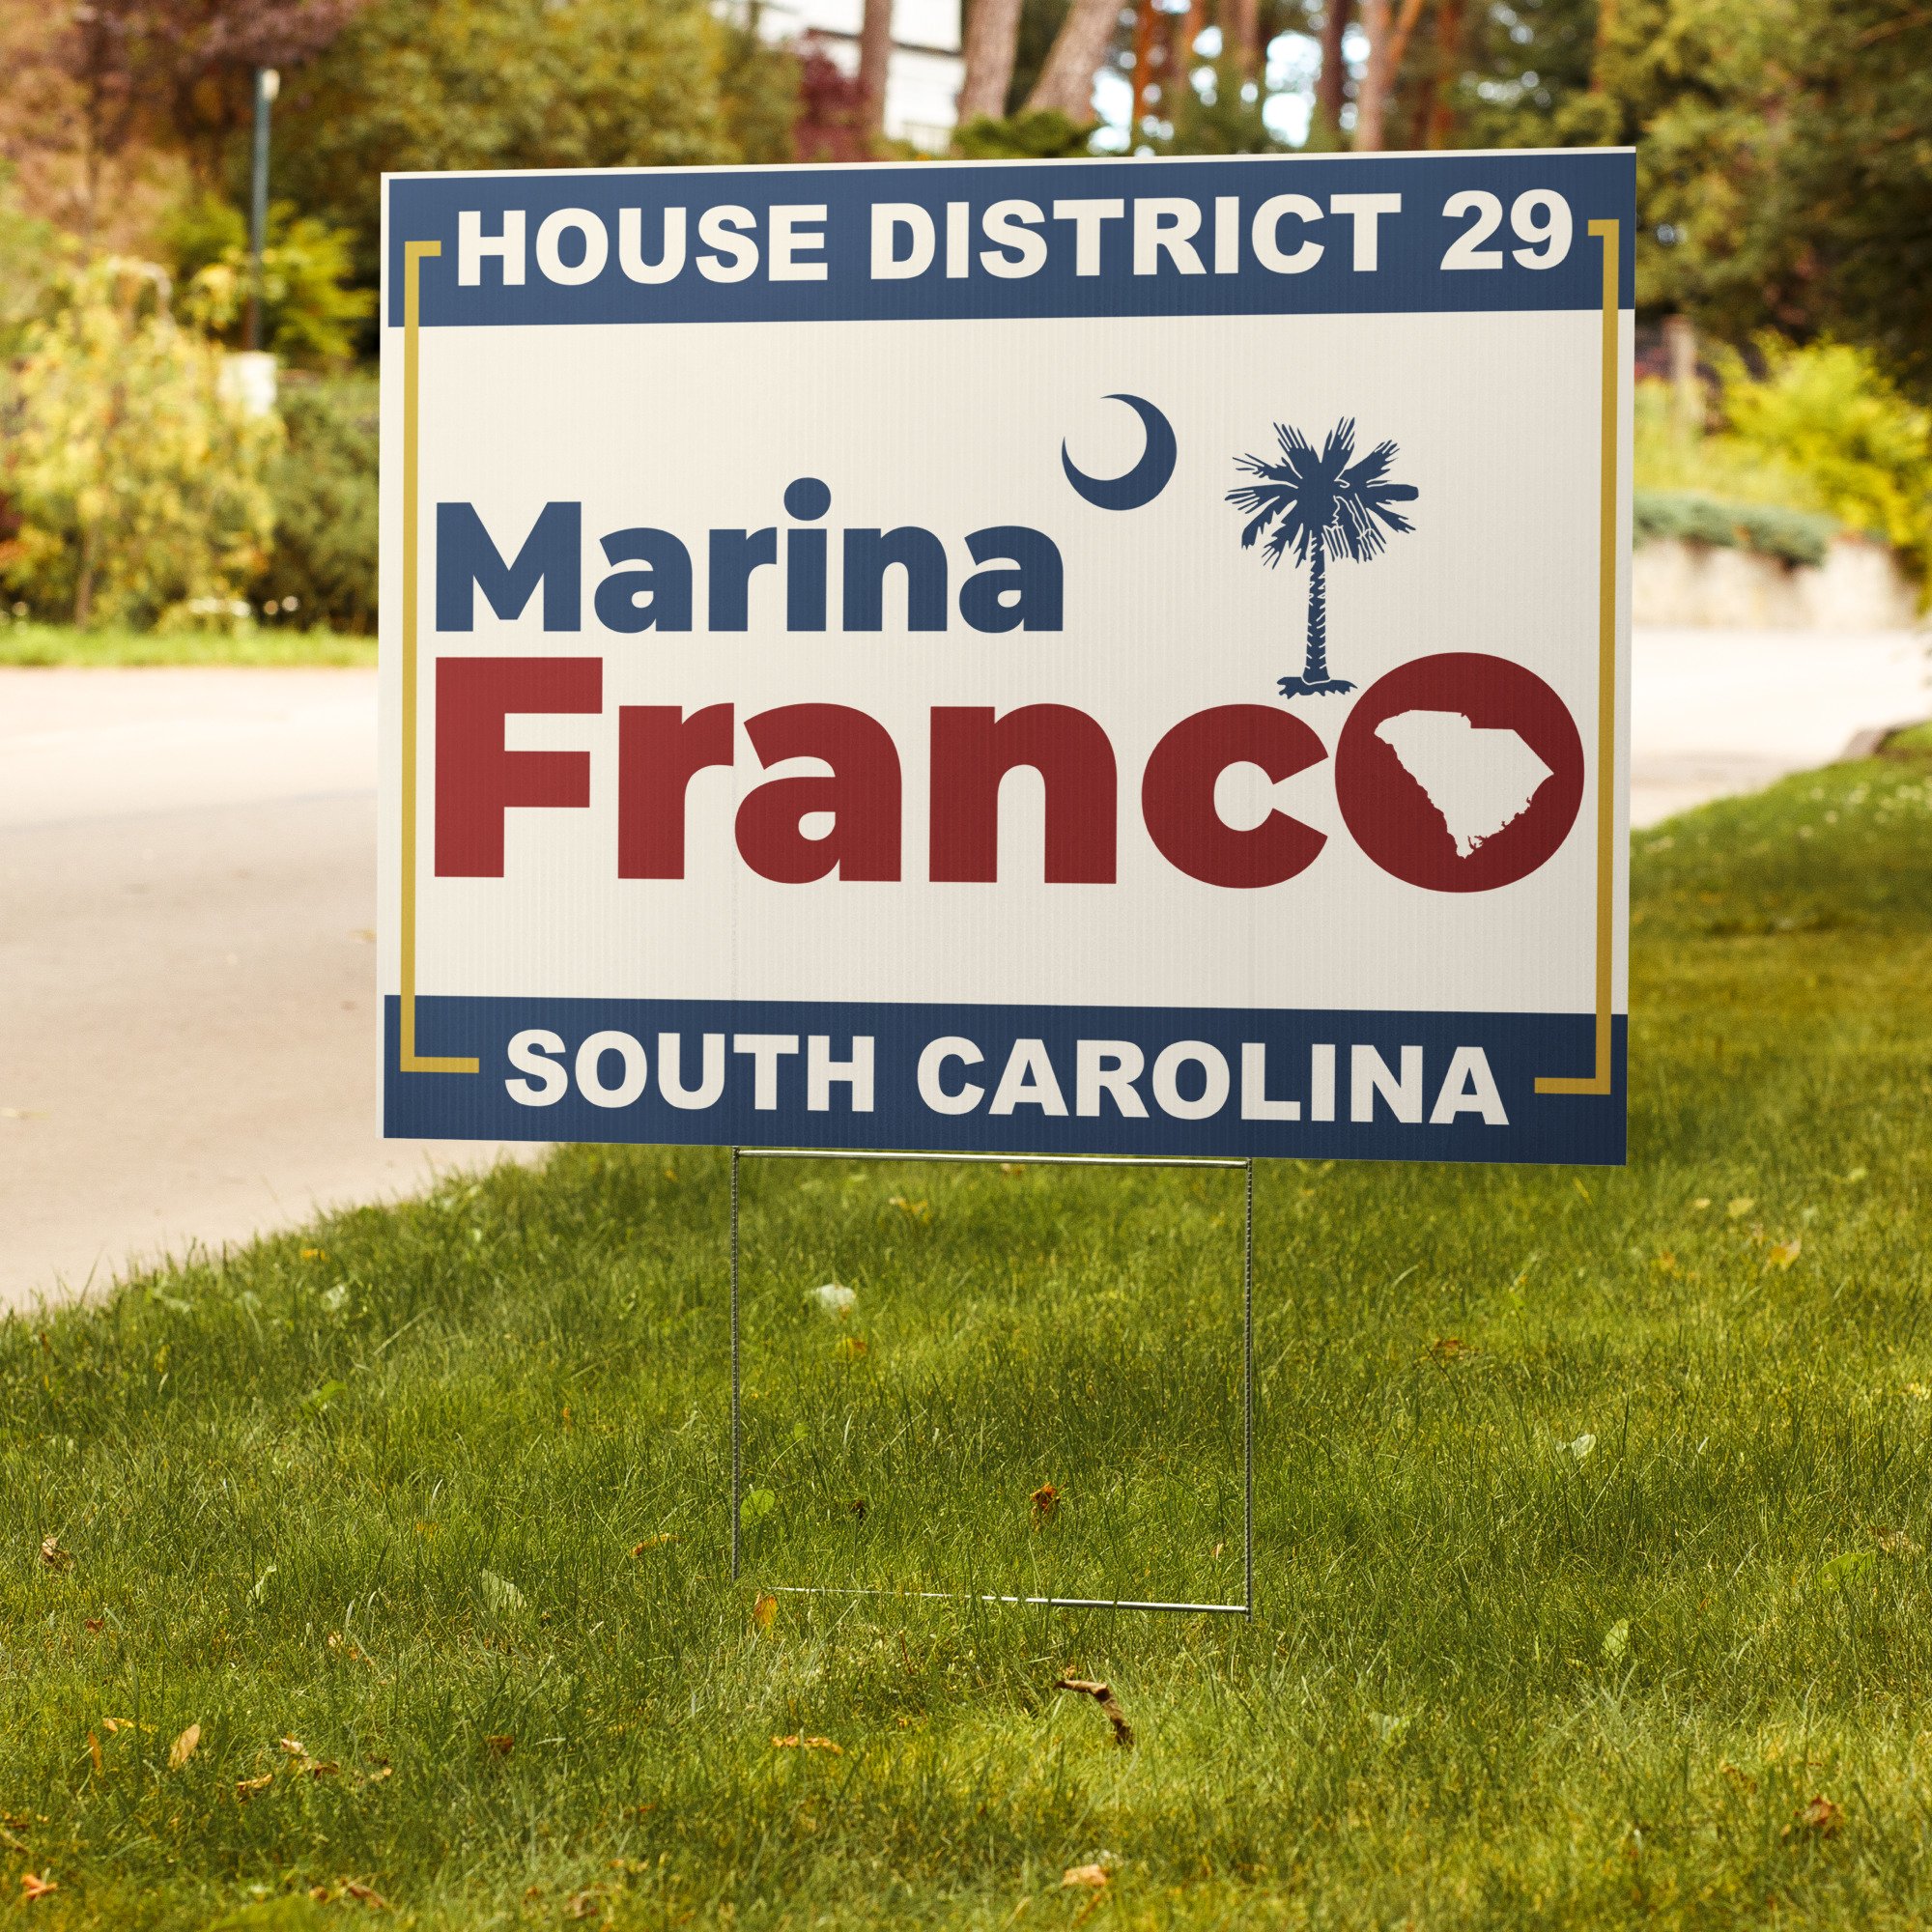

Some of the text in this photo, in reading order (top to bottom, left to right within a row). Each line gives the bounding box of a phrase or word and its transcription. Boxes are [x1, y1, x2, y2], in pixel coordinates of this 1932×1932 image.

[457, 188, 1574, 287] HOUSE DISTRICT 29
[436, 477, 1064, 633] Marina
[504, 1029, 1510, 1126] SOUTH CAROLINA
